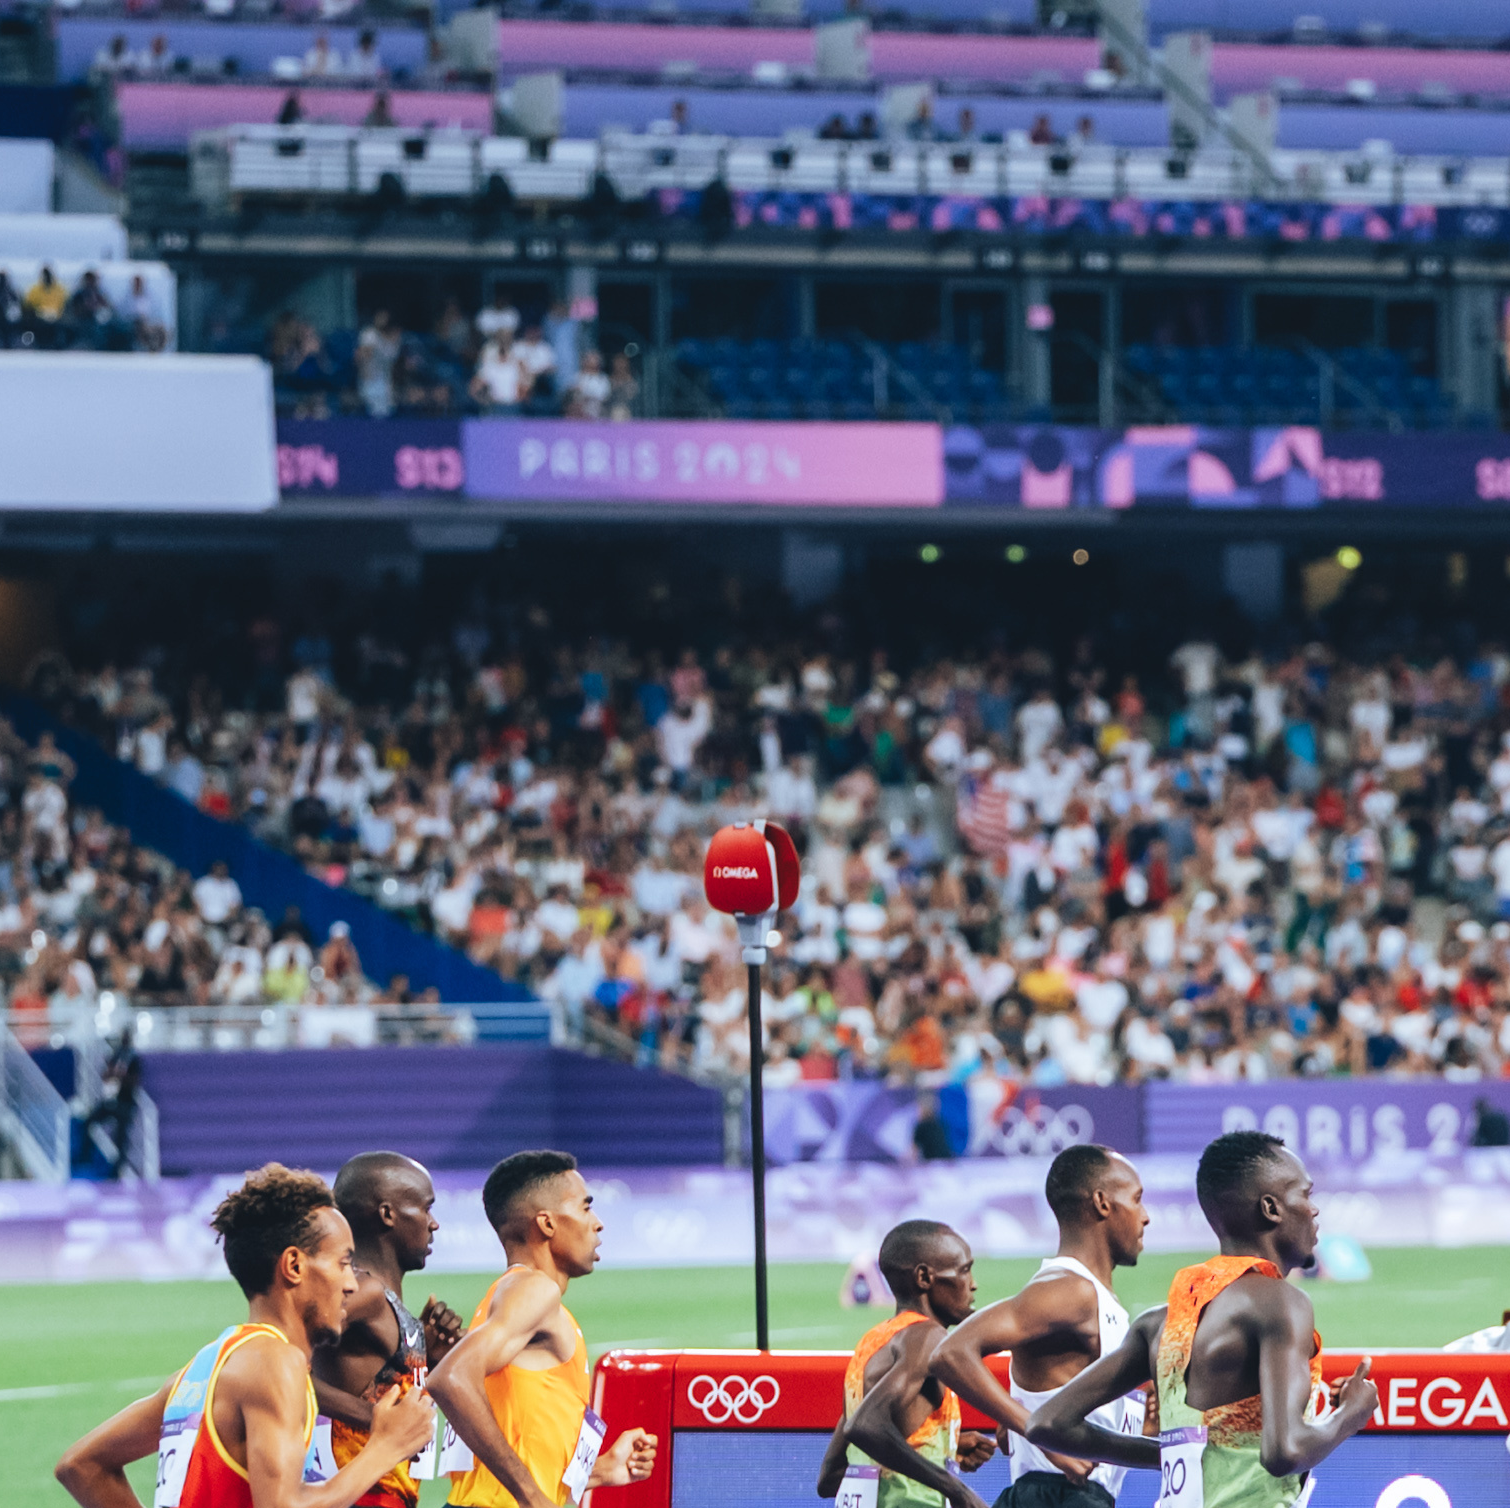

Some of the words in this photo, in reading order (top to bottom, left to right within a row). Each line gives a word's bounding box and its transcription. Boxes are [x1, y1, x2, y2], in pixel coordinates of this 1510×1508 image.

[518, 437, 662, 481] PARIS
[672, 439, 802, 485] 2024
[722, 866, 759, 879] OMEGA
